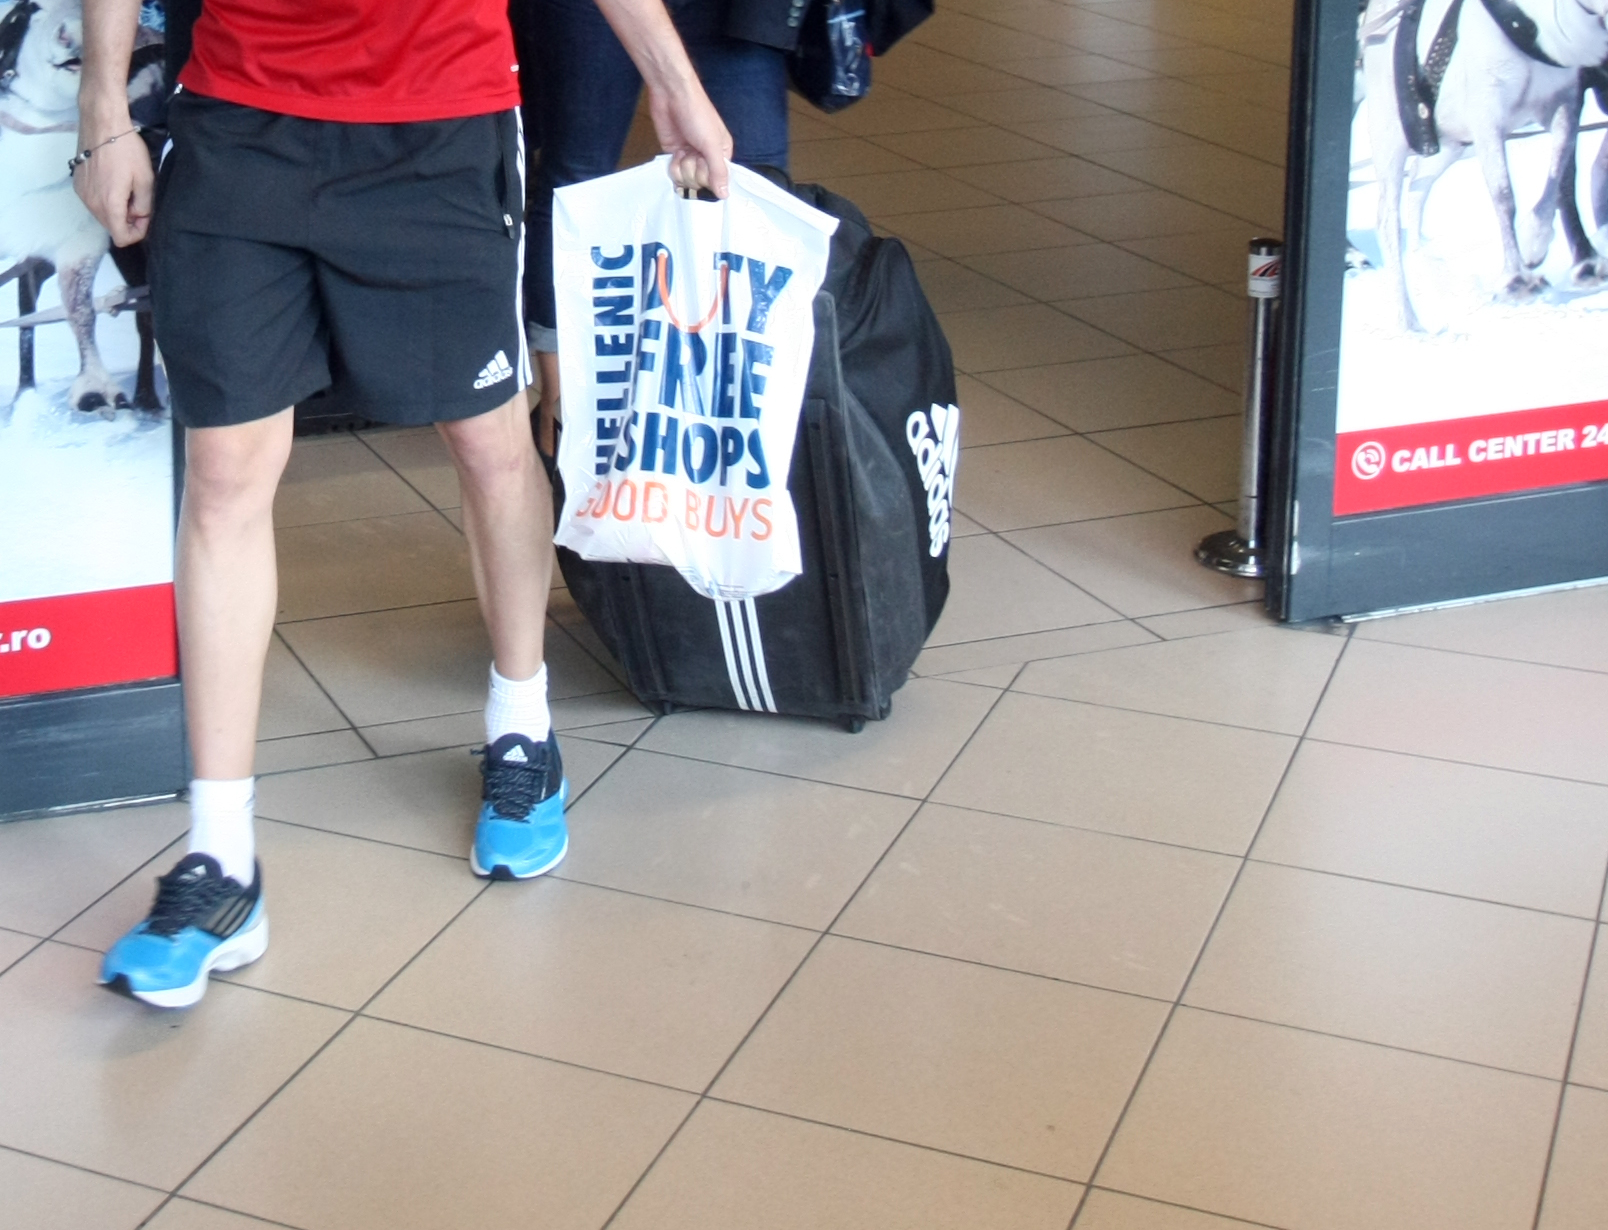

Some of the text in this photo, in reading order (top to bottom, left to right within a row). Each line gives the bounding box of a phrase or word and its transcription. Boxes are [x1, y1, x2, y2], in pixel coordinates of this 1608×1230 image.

[591, 244, 634, 476] HELLENIC
[614, 410, 771, 490] SHOPS
[905, 410, 950, 558] adidas
[1391, 443, 1463, 472] CALL
[1467, 427, 1575, 463] CENTER
[685, 489, 773, 542] BUYS
